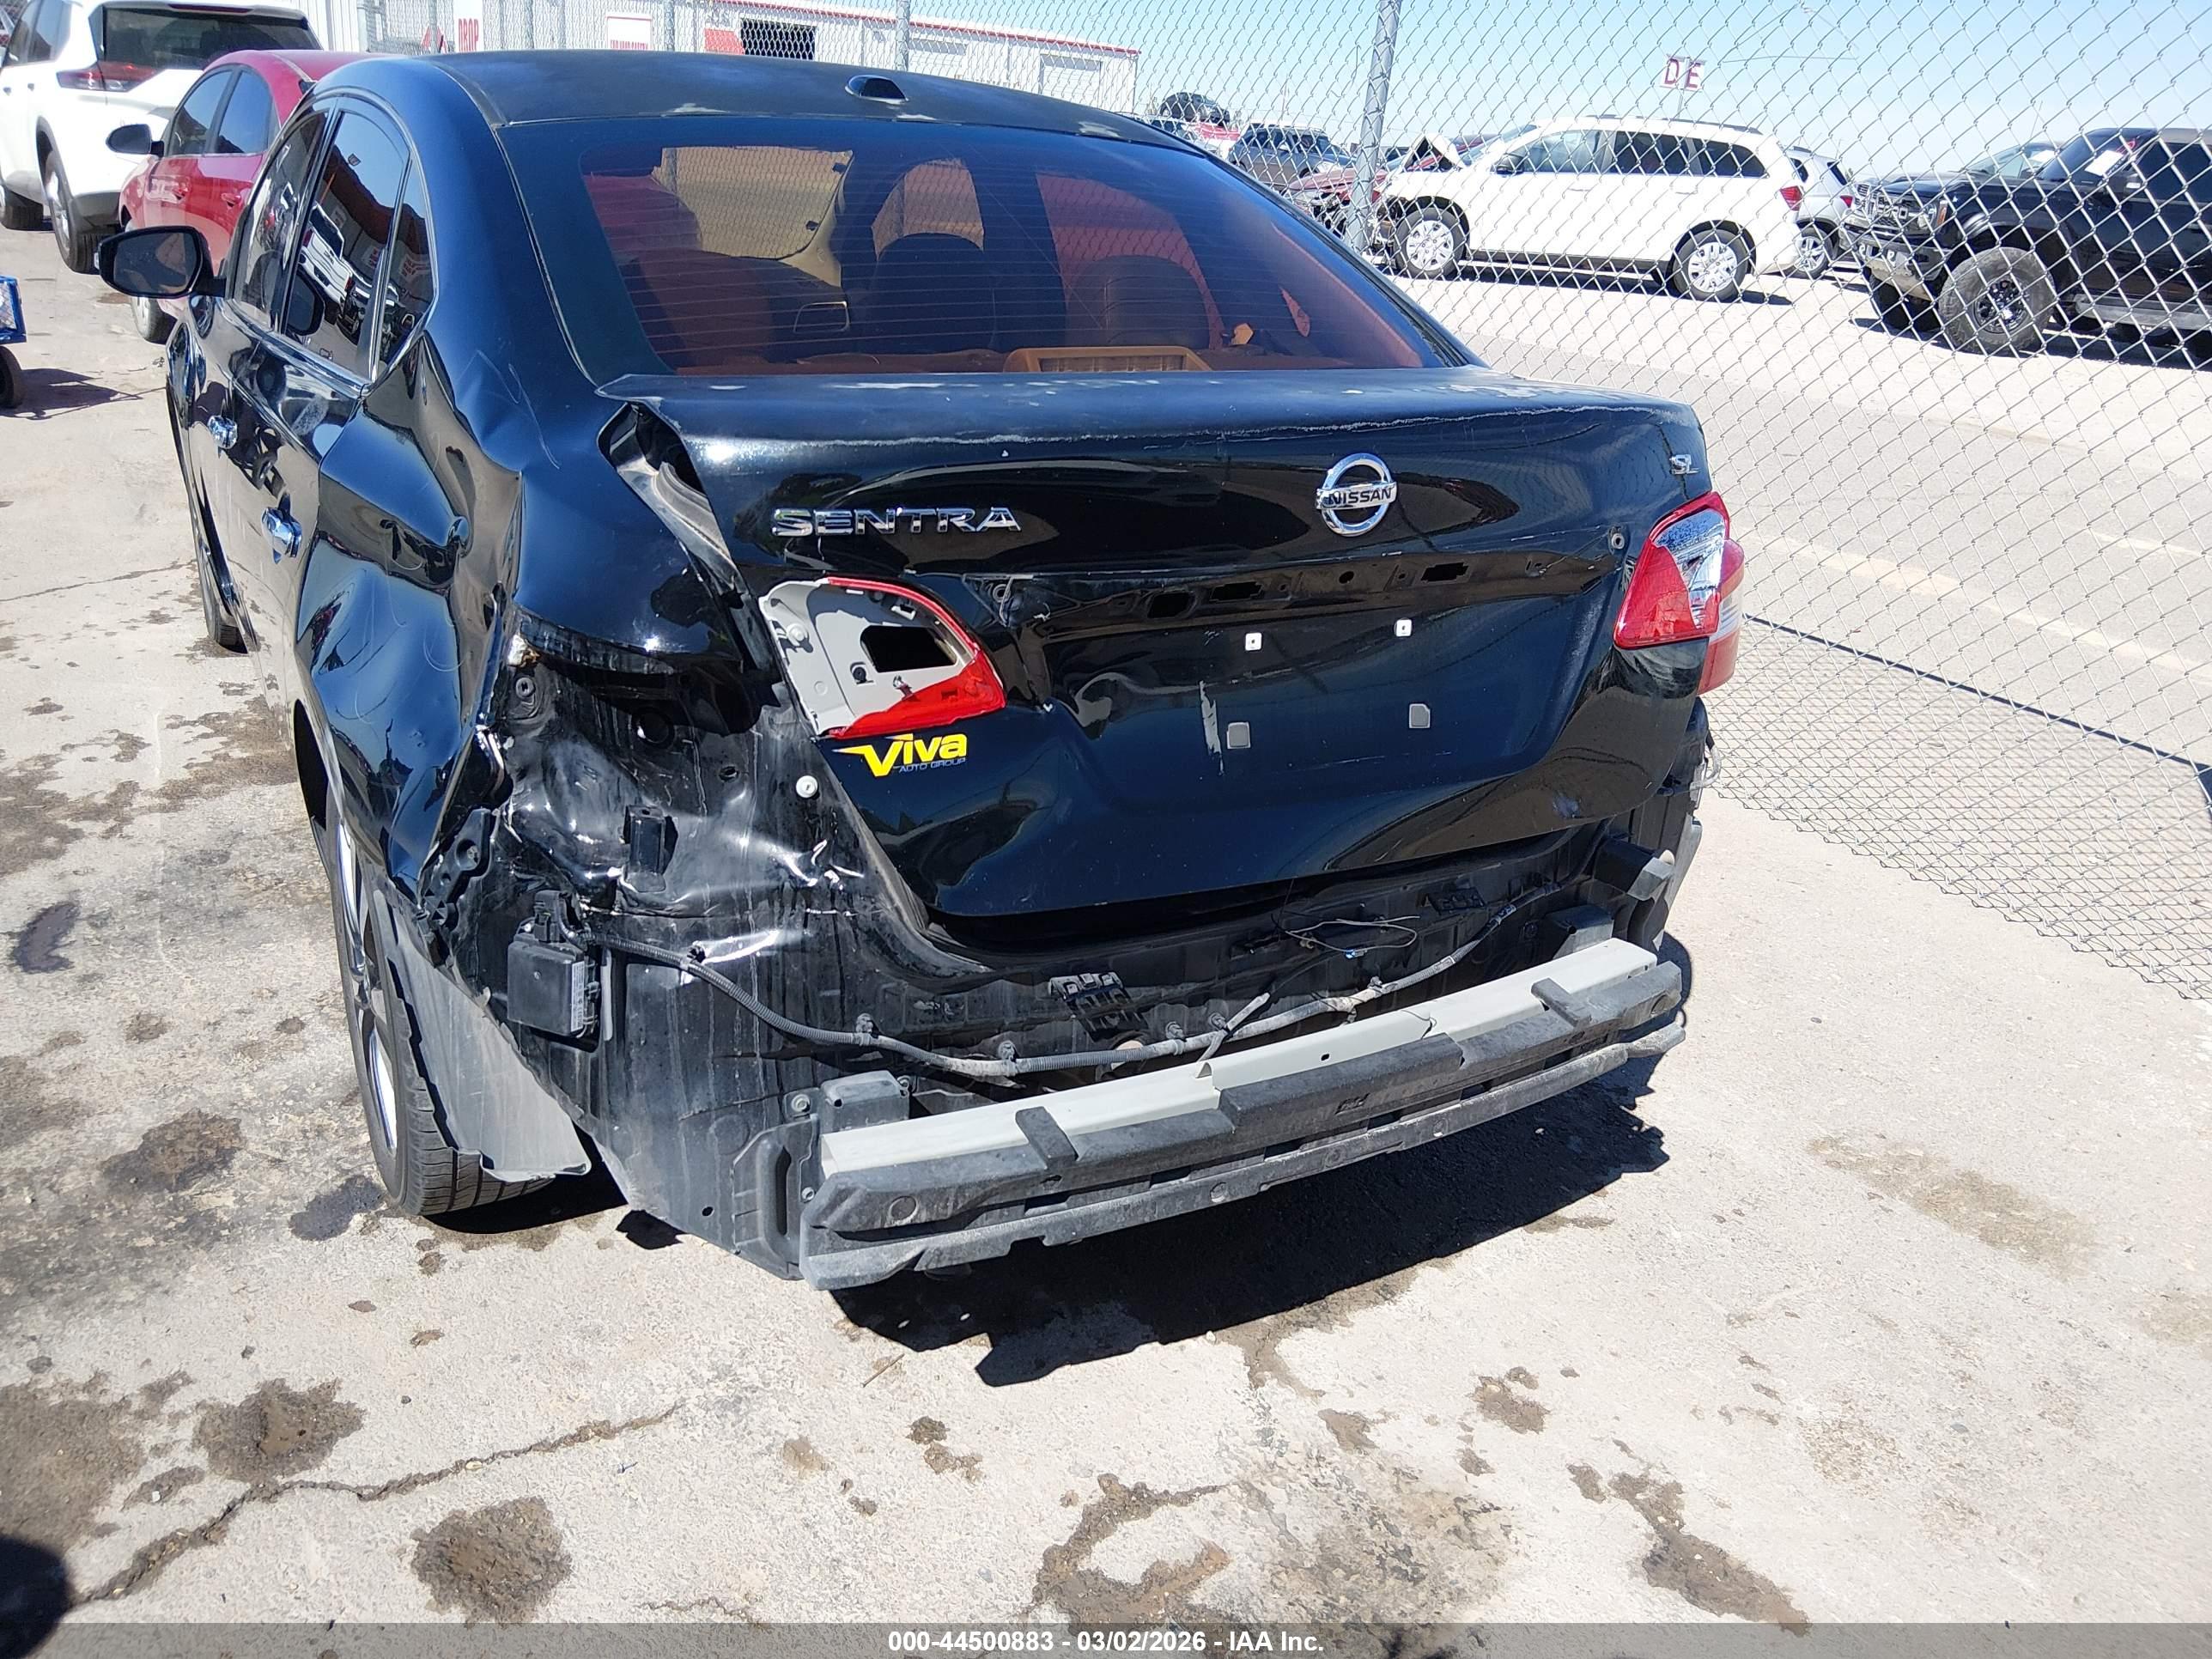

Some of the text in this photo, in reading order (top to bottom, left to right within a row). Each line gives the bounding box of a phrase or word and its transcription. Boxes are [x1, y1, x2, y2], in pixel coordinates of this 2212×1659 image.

[1328, 487, 1392, 506] NISSAN
[772, 507, 1022, 537] SENTRA
[831, 732, 967, 777] Viva
[898, 757, 967, 774] AUTO GROUP
